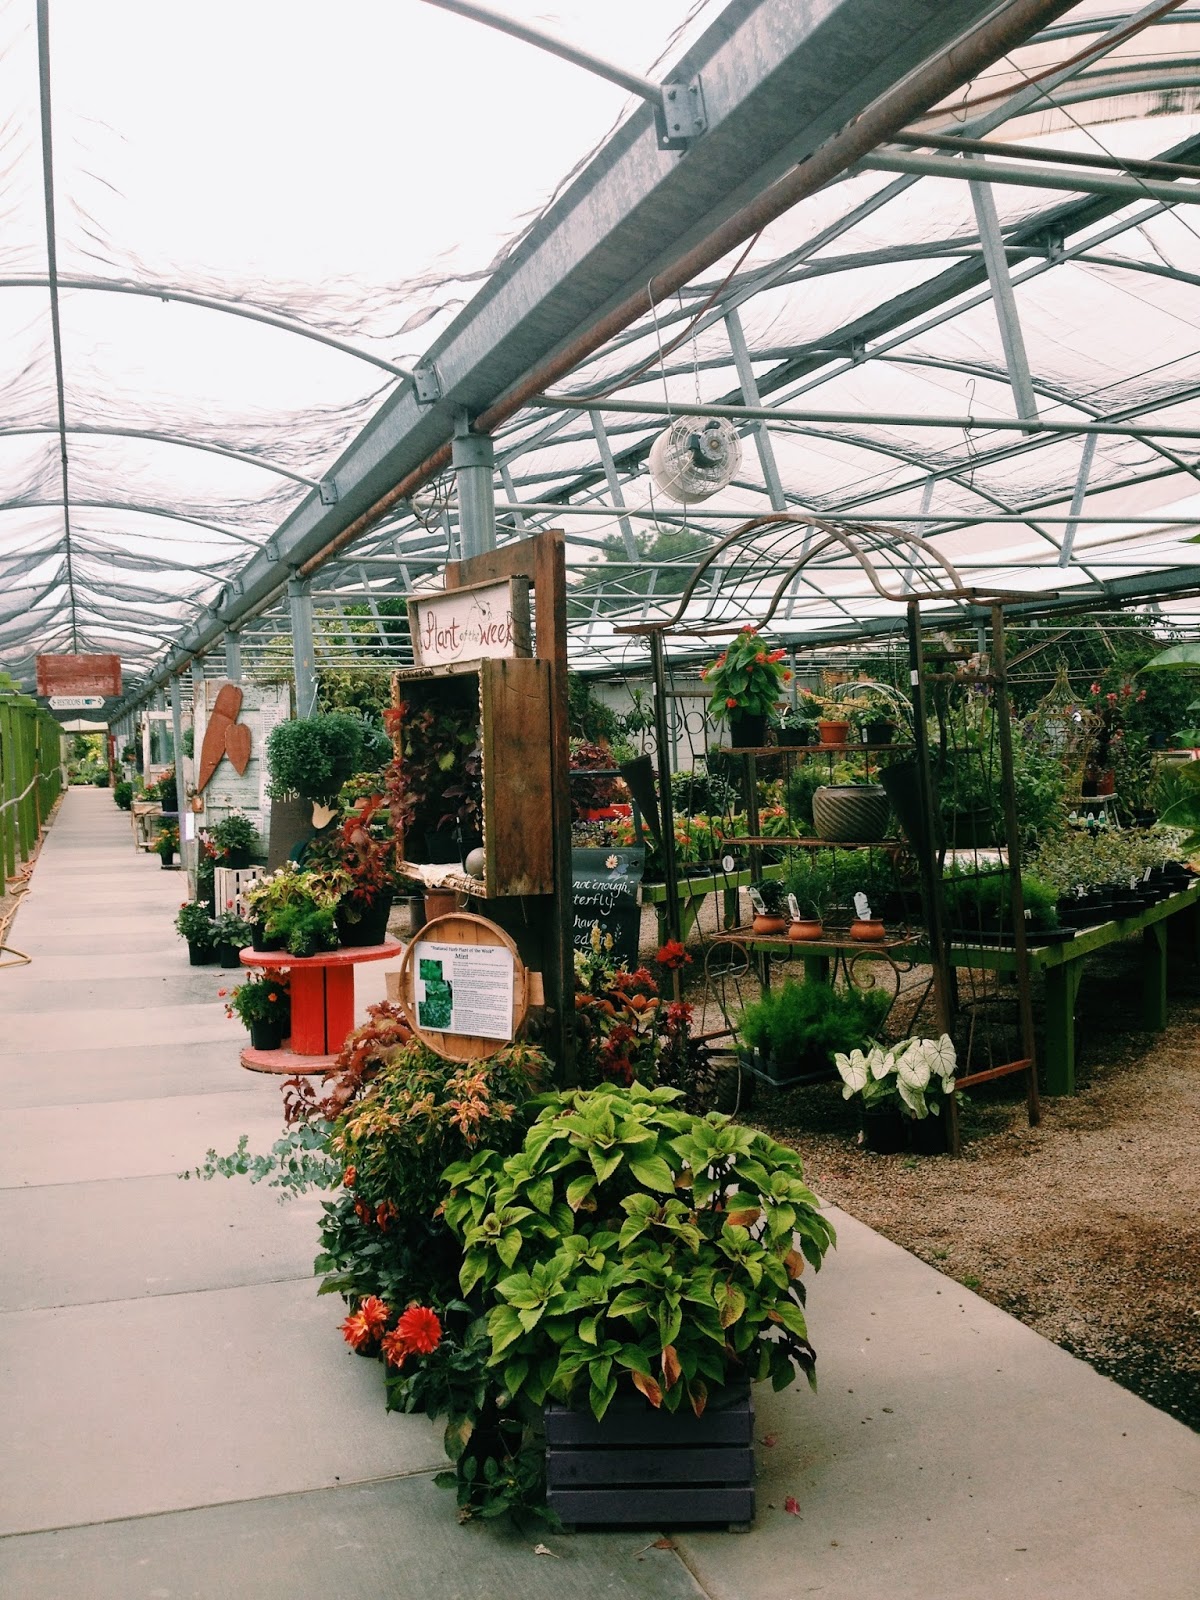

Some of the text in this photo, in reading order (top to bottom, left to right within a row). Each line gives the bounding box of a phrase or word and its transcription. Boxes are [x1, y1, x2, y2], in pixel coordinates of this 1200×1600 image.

[424, 611, 513, 653] Plant of the Week
[56, 698, 81, 706] RESTROOMS
[572, 880, 591, 889] not
